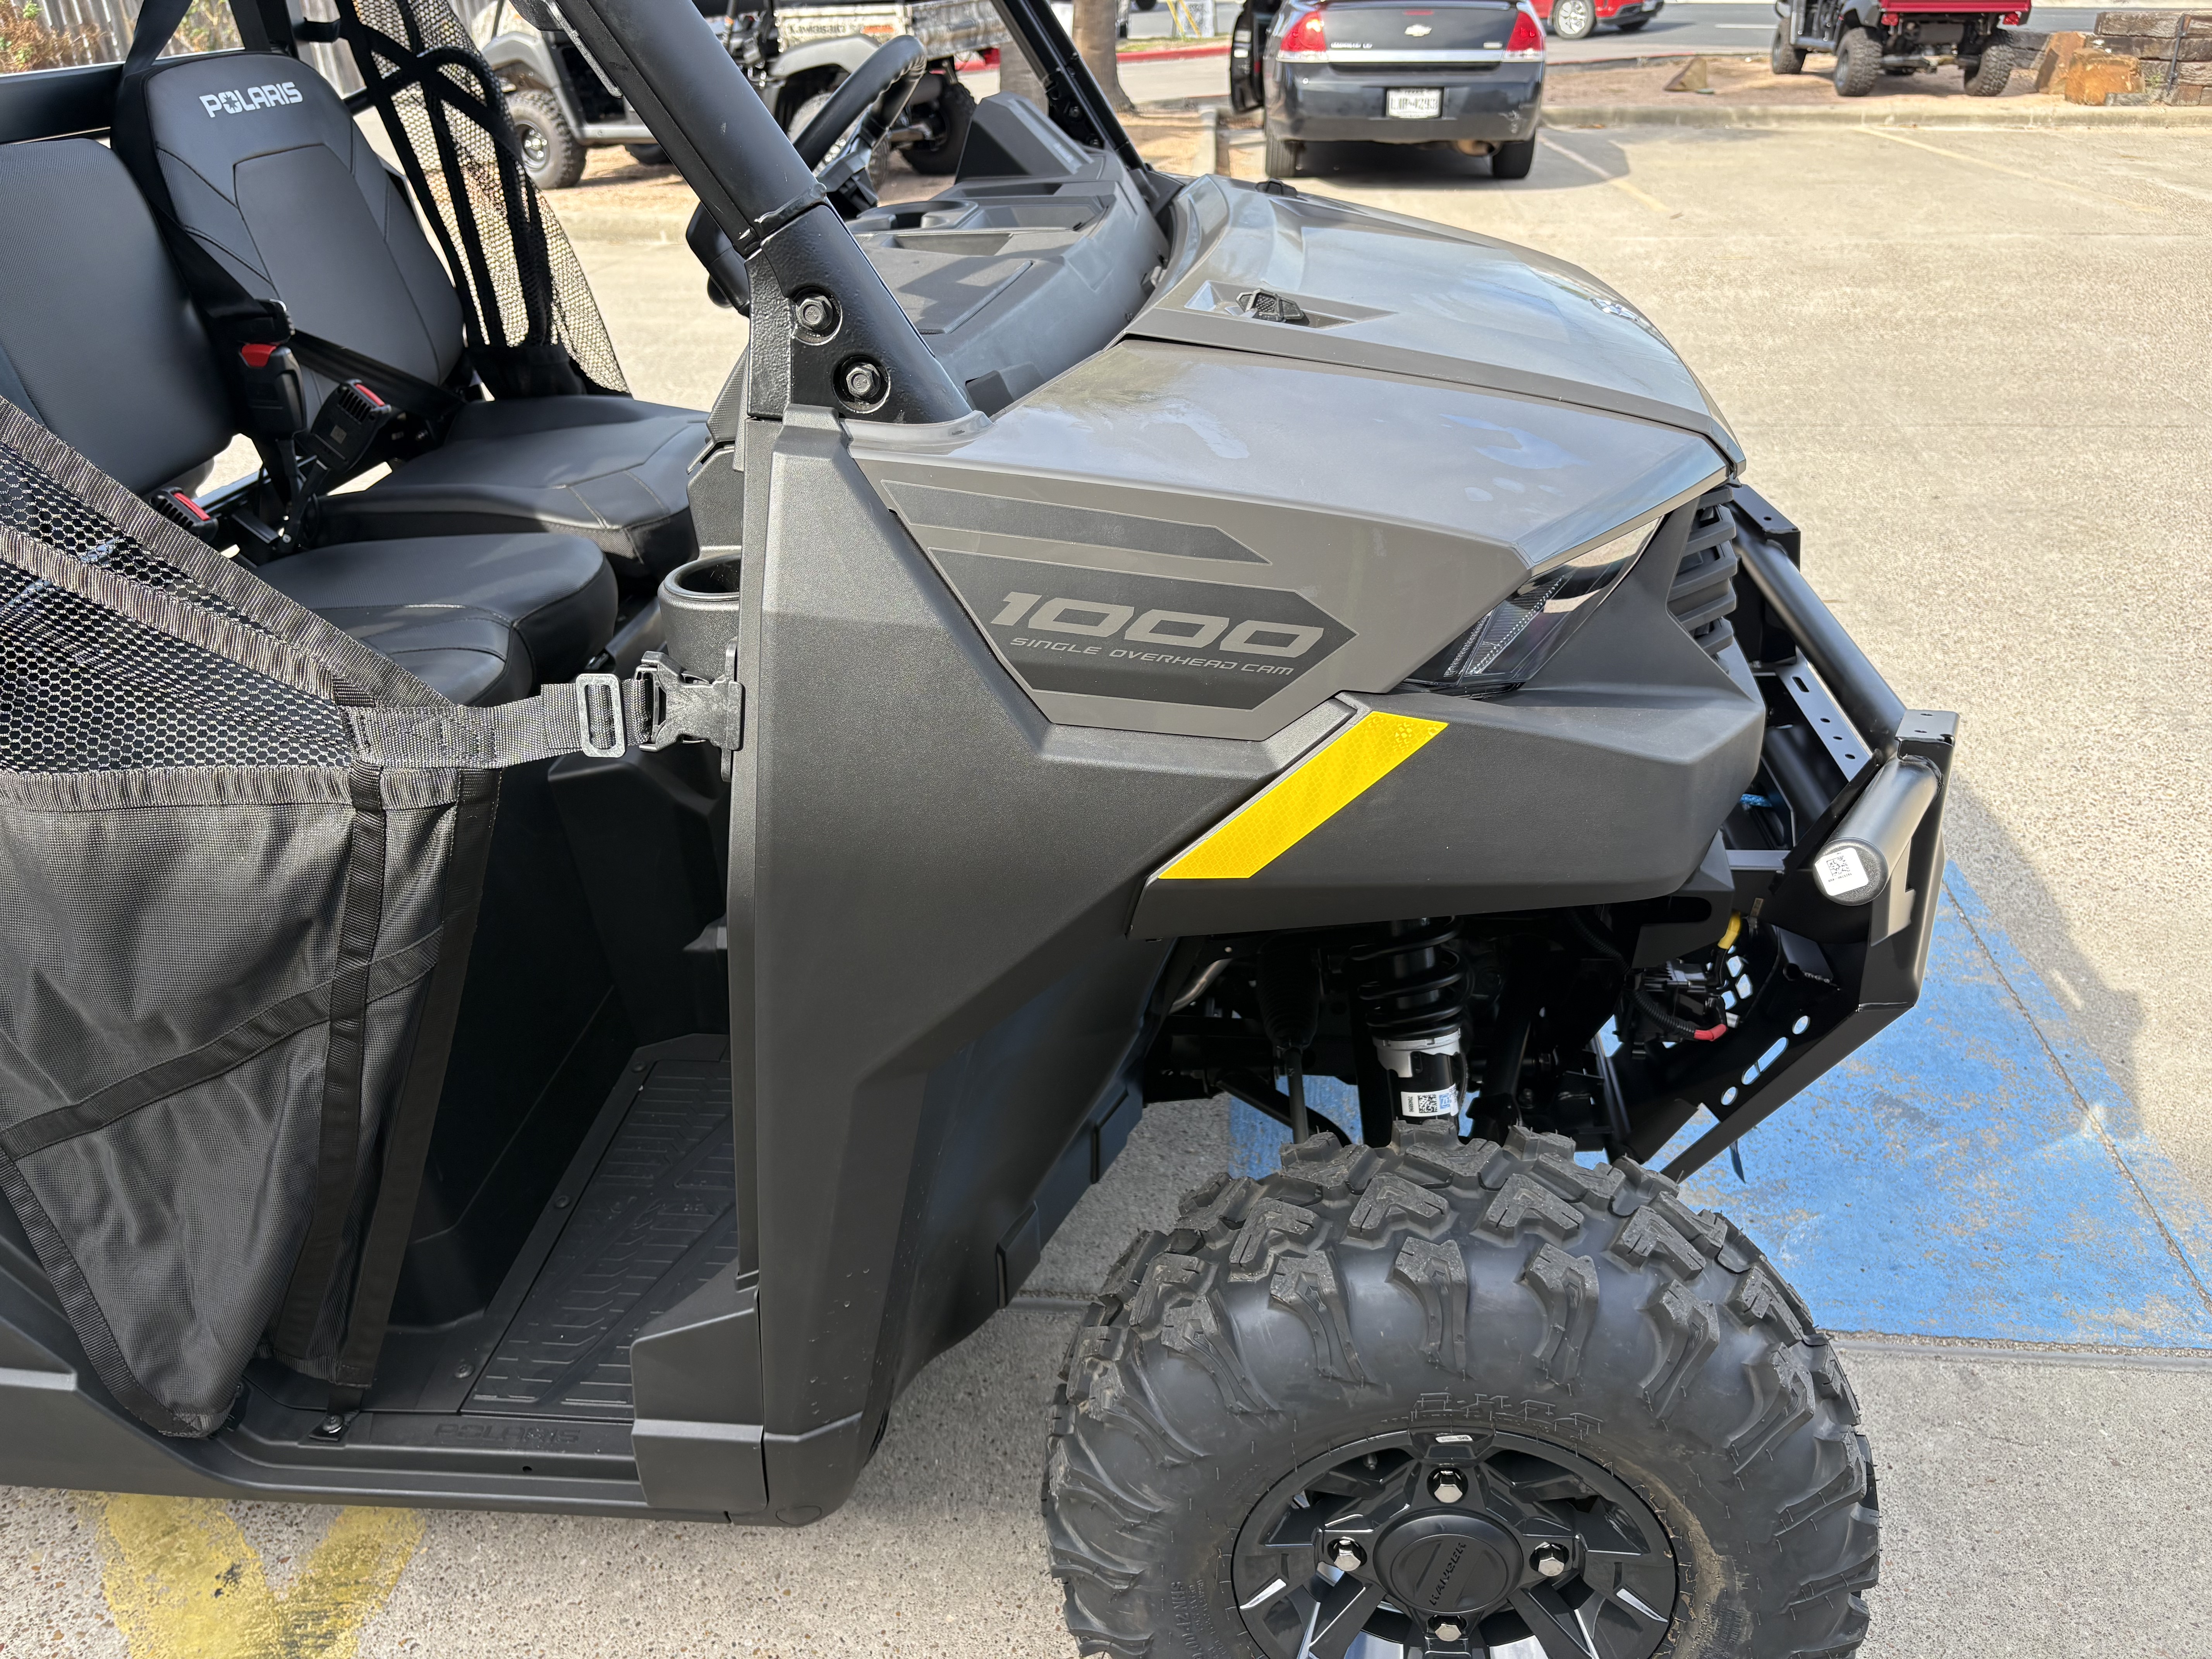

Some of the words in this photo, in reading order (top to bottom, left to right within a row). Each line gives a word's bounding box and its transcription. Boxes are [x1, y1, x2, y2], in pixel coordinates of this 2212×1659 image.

[199, 81, 303, 118] POLARIS
[991, 591, 1324, 658] 1000
[1010, 637, 1102, 654] SINGLE
[1109, 649, 1237, 670] OVERHEAD
[1240, 664, 1294, 675] CAM
[433, 1423, 581, 1444] POLARIS
